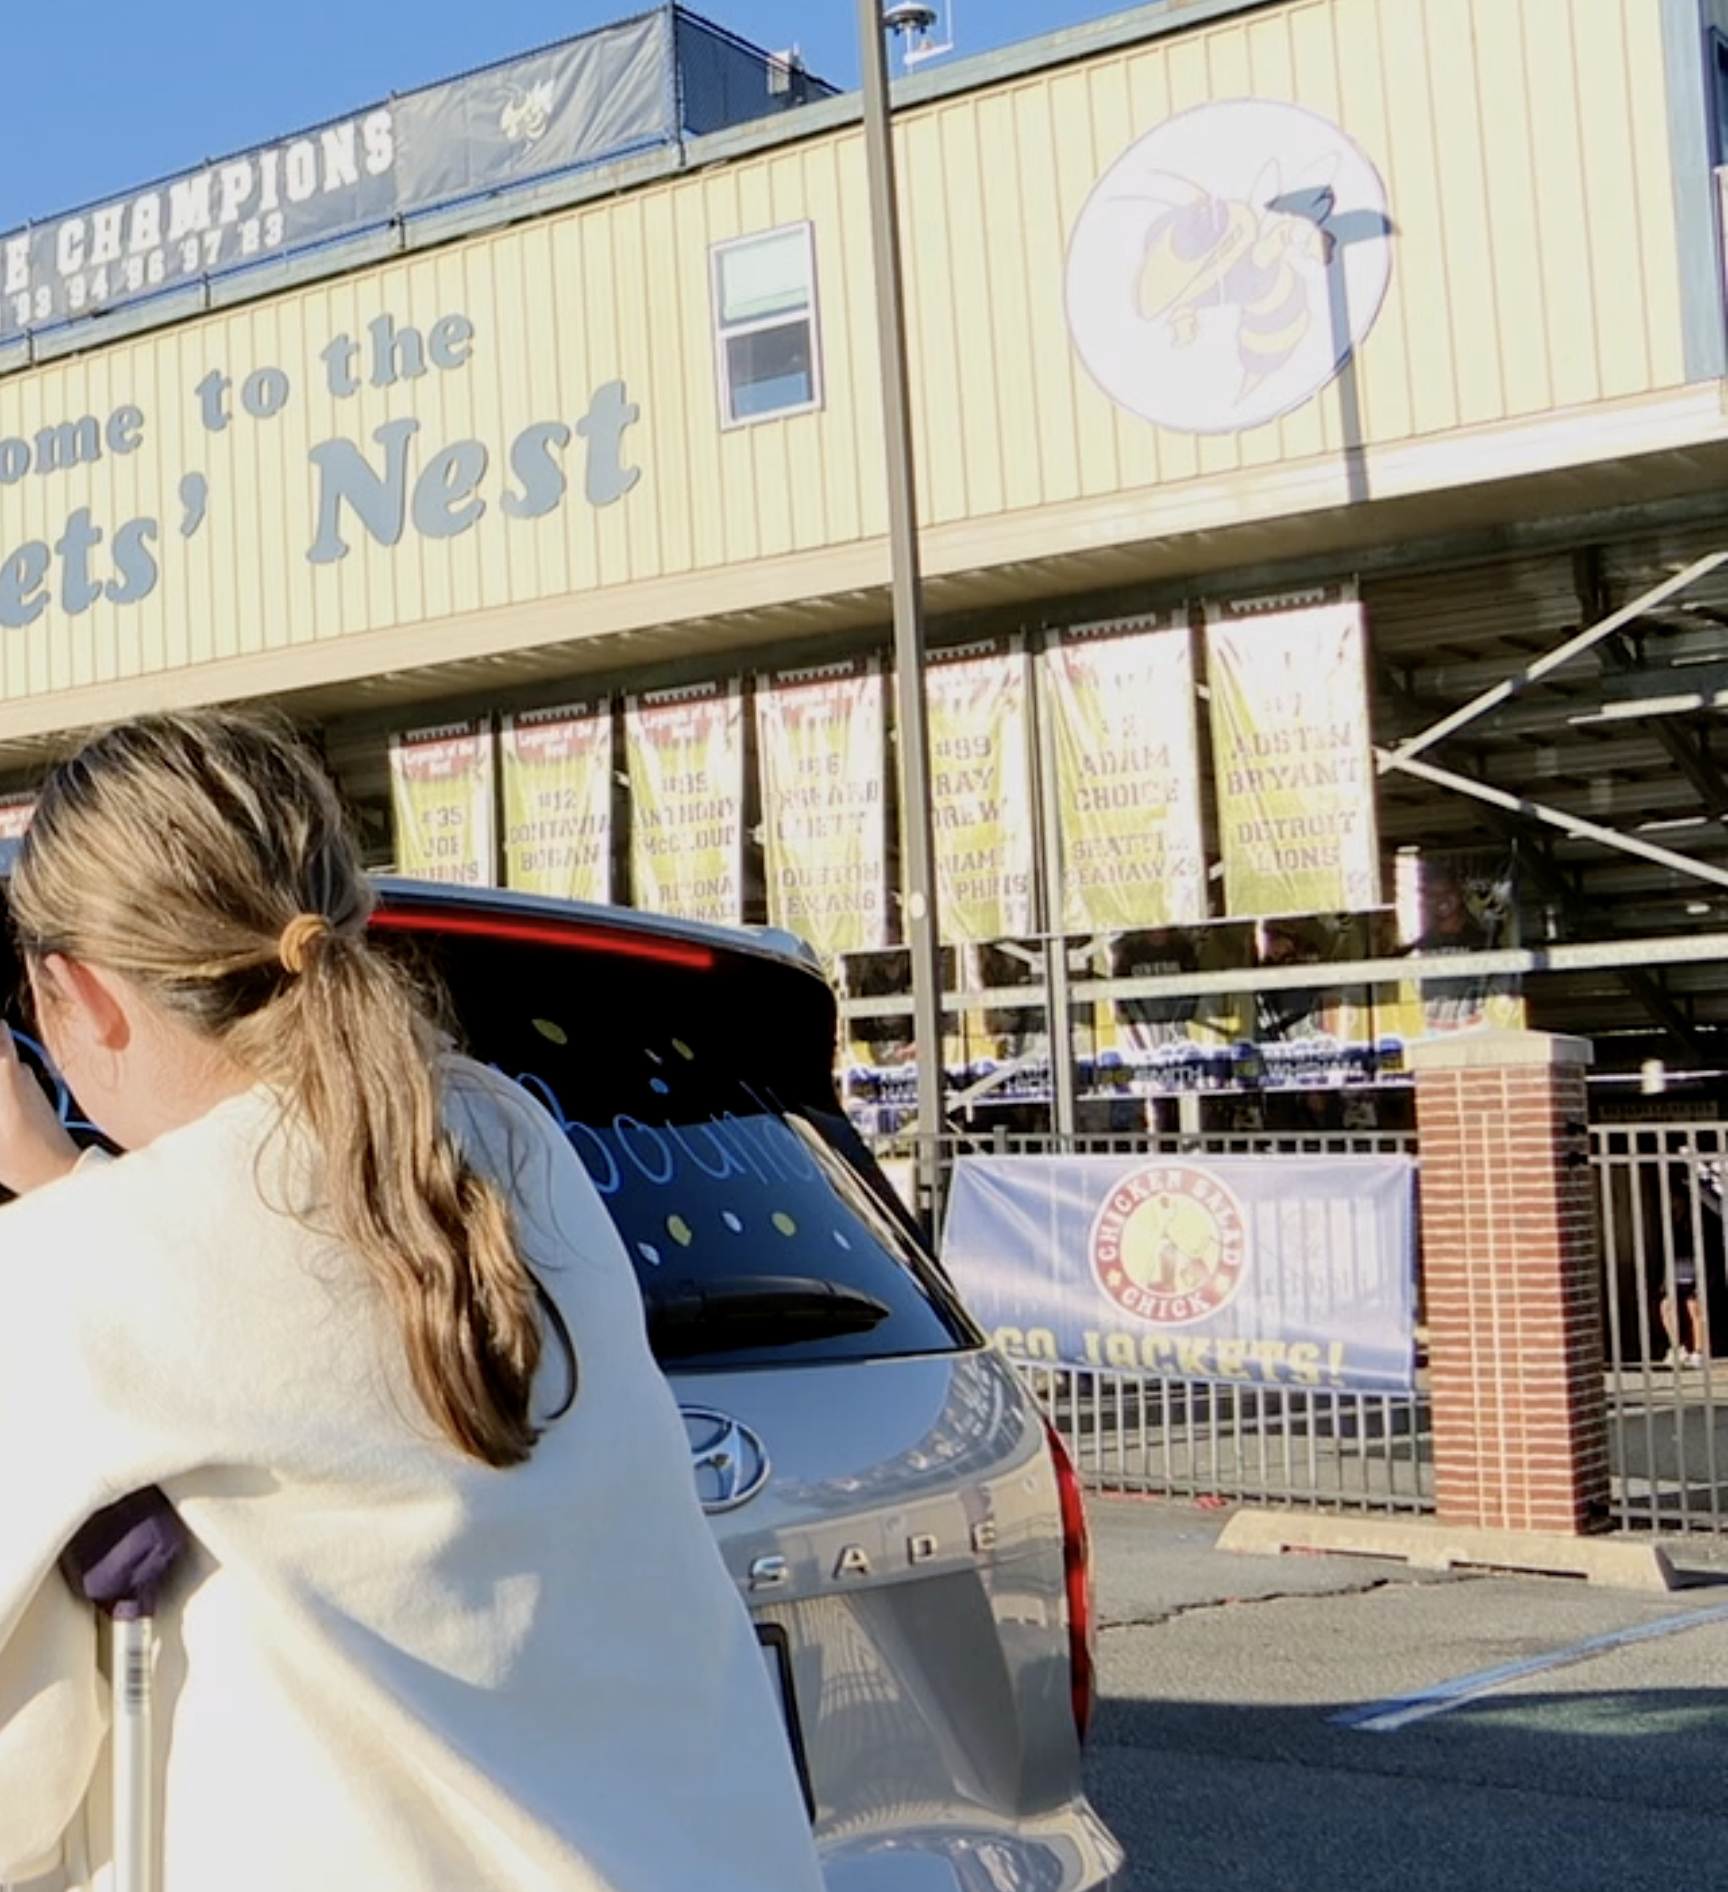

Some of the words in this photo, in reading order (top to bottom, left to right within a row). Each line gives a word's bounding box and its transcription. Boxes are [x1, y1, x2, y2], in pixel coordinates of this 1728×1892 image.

[56, 110, 394, 276] CHAMPIONS
[64, 268, 109, 310] '94
[178, 228, 223, 273] '97
[194, 366, 290, 433] to
[321, 311, 474, 400] the
[305, 379, 643, 566] Nest
[935, 736, 992, 760] #99
[1078, 743, 1170, 780] ADAM
[935, 766, 995, 797] RAY
[1074, 776, 1180, 812] CHOICE
[1227, 757, 1359, 797] BRYANT
[538, 789, 577, 811] #12
[1072, 830, 1189, 861] SEATTL
[1236, 810, 1358, 845] DETROIT
[423, 835, 460, 858] JOE
[1257, 846, 1339, 872] LIONS
[1097, 1169, 1183, 1263] CHICKEN
[1191, 1175, 1242, 1266] SALAD
[1121, 1284, 1212, 1318] CHICK
[993, 1325, 1058, 1361] GO
[1082, 1330, 1346, 1387] JACKETS!
